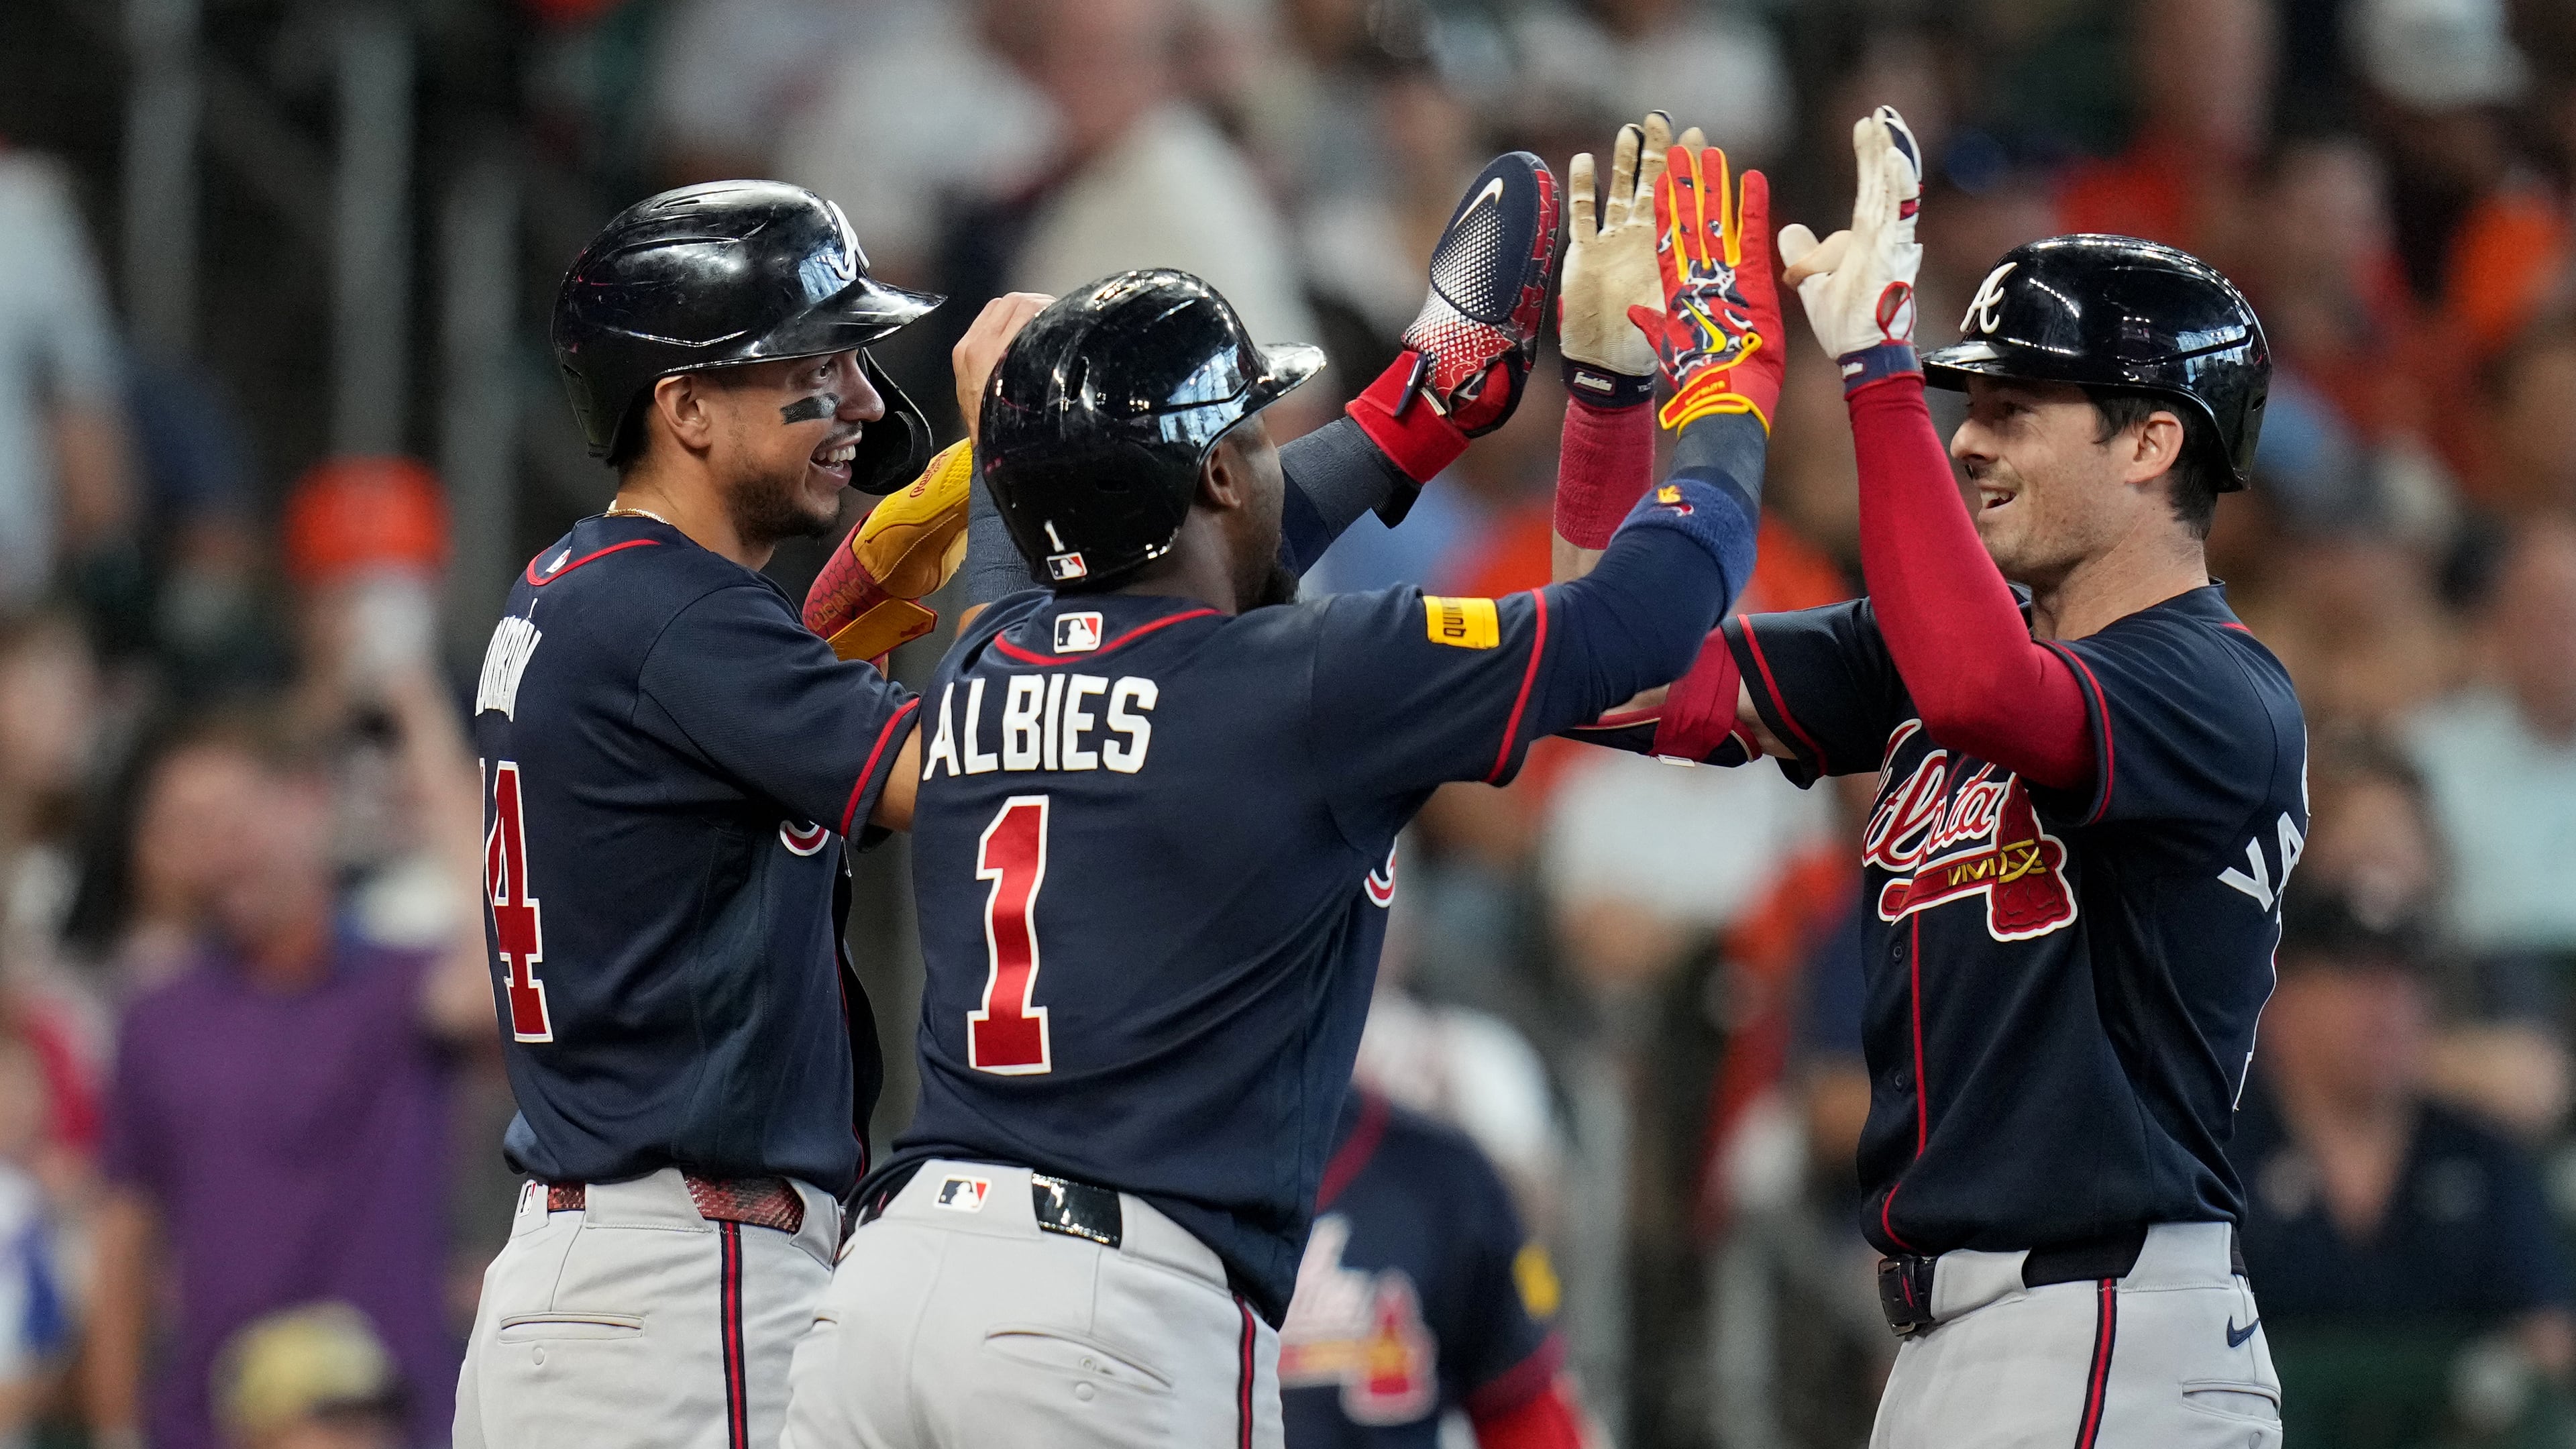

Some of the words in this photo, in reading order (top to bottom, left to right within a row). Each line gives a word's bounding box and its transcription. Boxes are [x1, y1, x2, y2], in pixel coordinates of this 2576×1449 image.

[1960, 262, 2018, 334] A
[1044, 519, 1065, 552] 1
[922, 673, 1159, 780] ALBIES
[479, 757, 553, 1042] 4
[967, 795, 1052, 1075] 1
